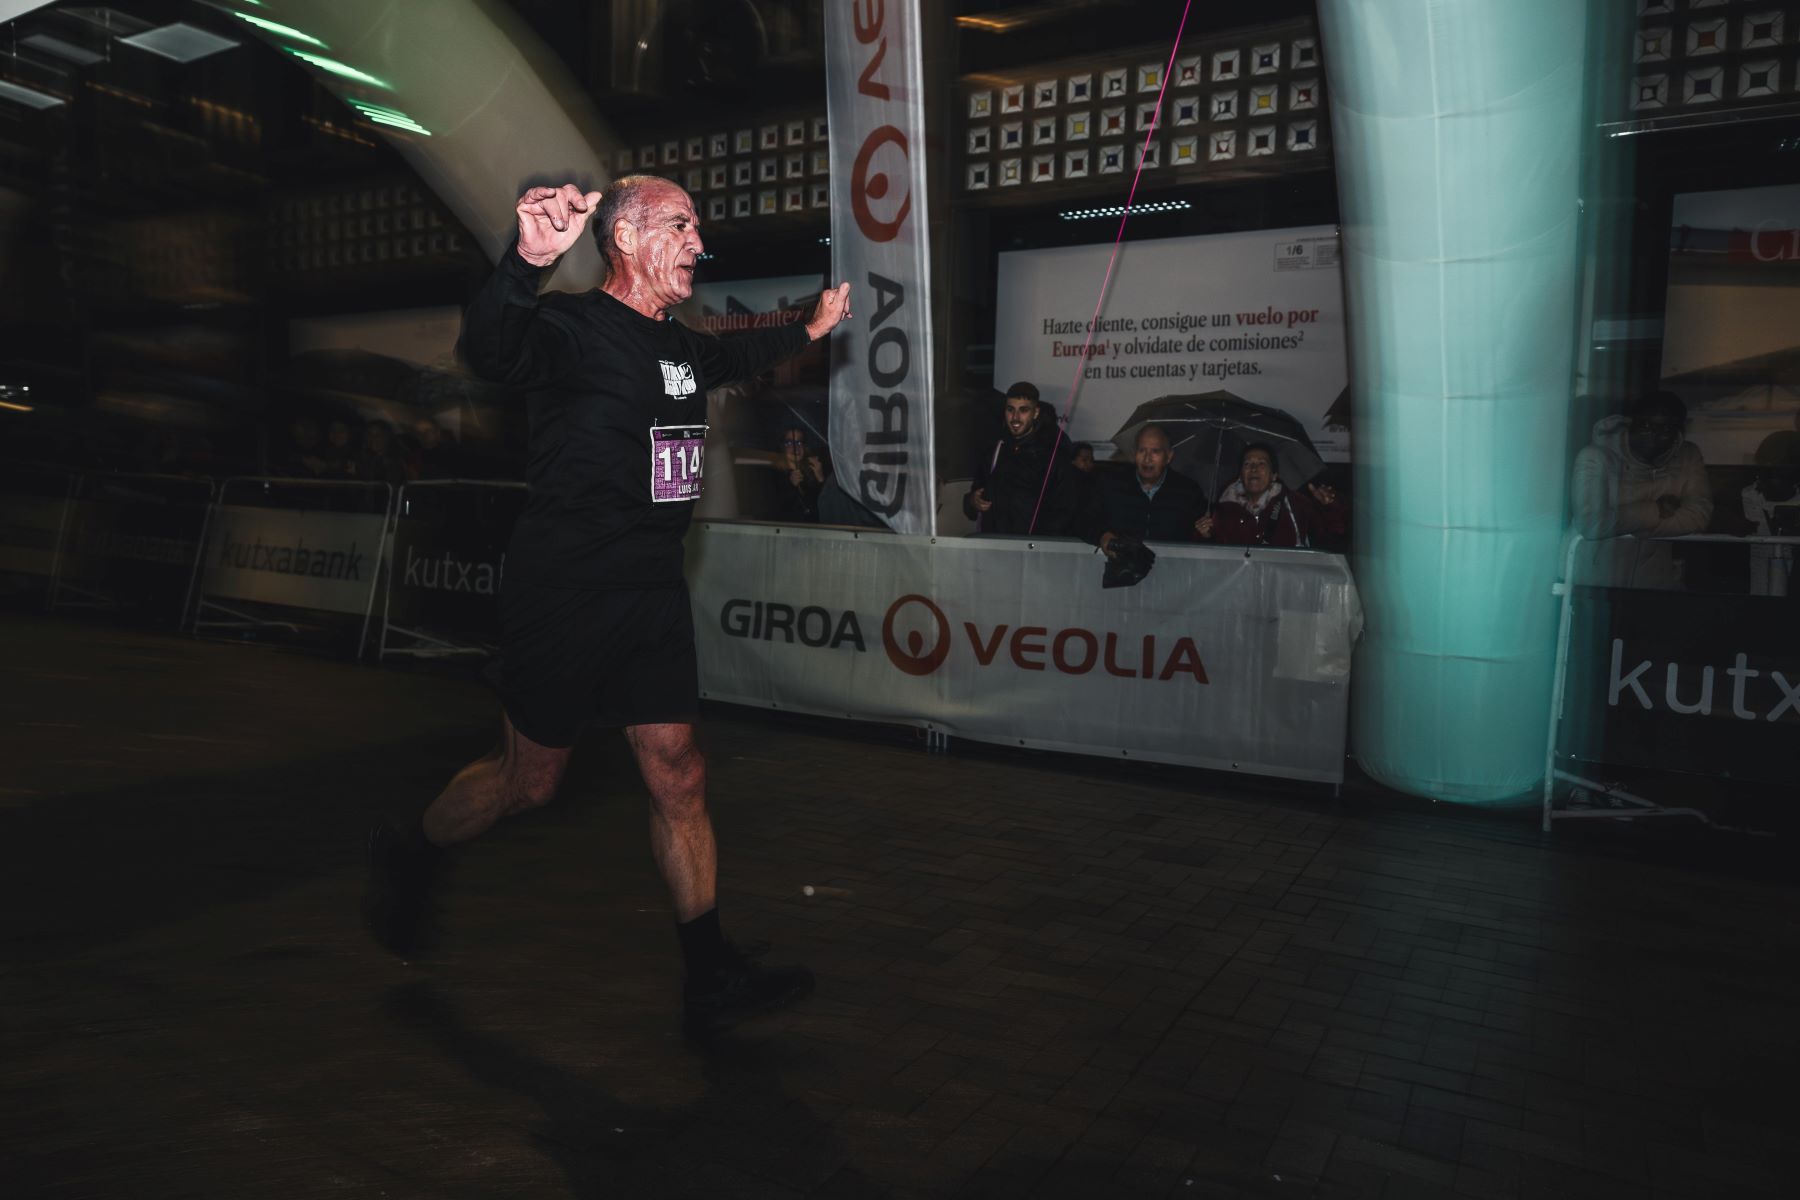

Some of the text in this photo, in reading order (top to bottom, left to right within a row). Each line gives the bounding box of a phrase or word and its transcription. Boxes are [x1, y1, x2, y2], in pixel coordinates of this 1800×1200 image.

[1043, 306, 1319, 335] Hazte cliente, consigue un vuelo por
[1112, 342, 1121, 360] y
[1186, 334, 1205, 352] de
[1084, 358, 1262, 381] en tus cuentas y tarjetas.
[219, 531, 364, 580] kutxabank
[720, 598, 1209, 684] GIROA VEOLIA
